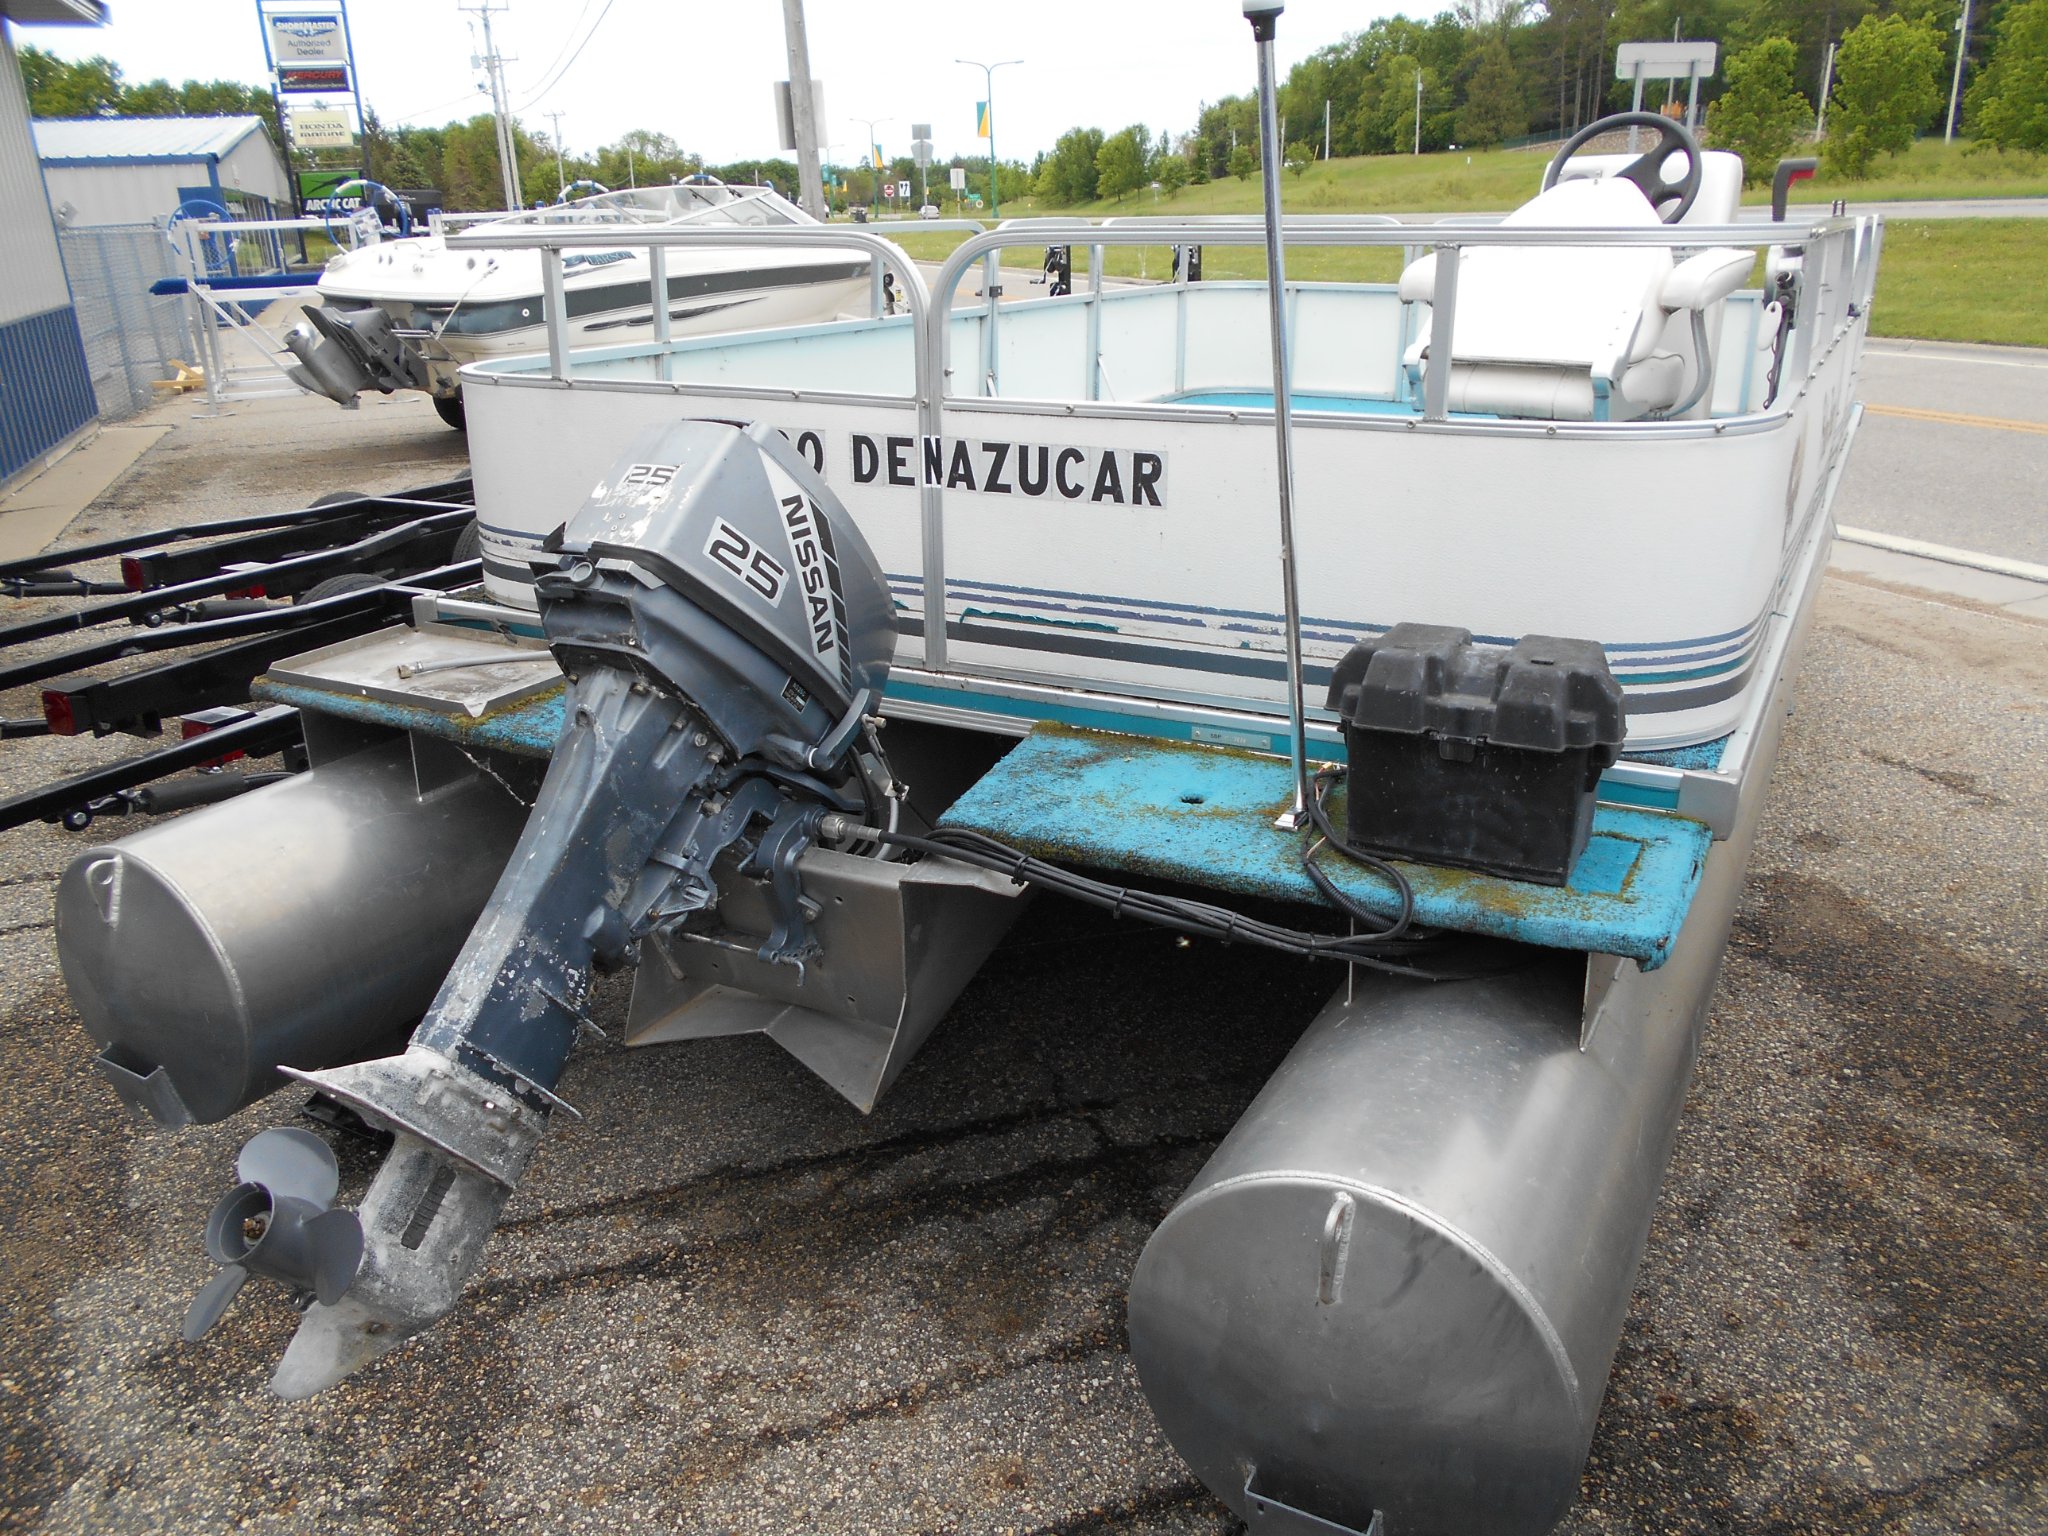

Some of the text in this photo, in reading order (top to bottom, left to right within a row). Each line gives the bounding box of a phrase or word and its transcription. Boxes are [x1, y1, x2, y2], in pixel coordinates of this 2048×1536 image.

[296, 48, 324, 56] Dealer
[285, 70, 343, 80] MERCURY
[299, 122, 345, 130] HONDA
[342, 197, 362, 209] CAT
[624, 465, 676, 486] 25
[708, 523, 785, 600] 25
[781, 494, 834, 654] NISSAN
